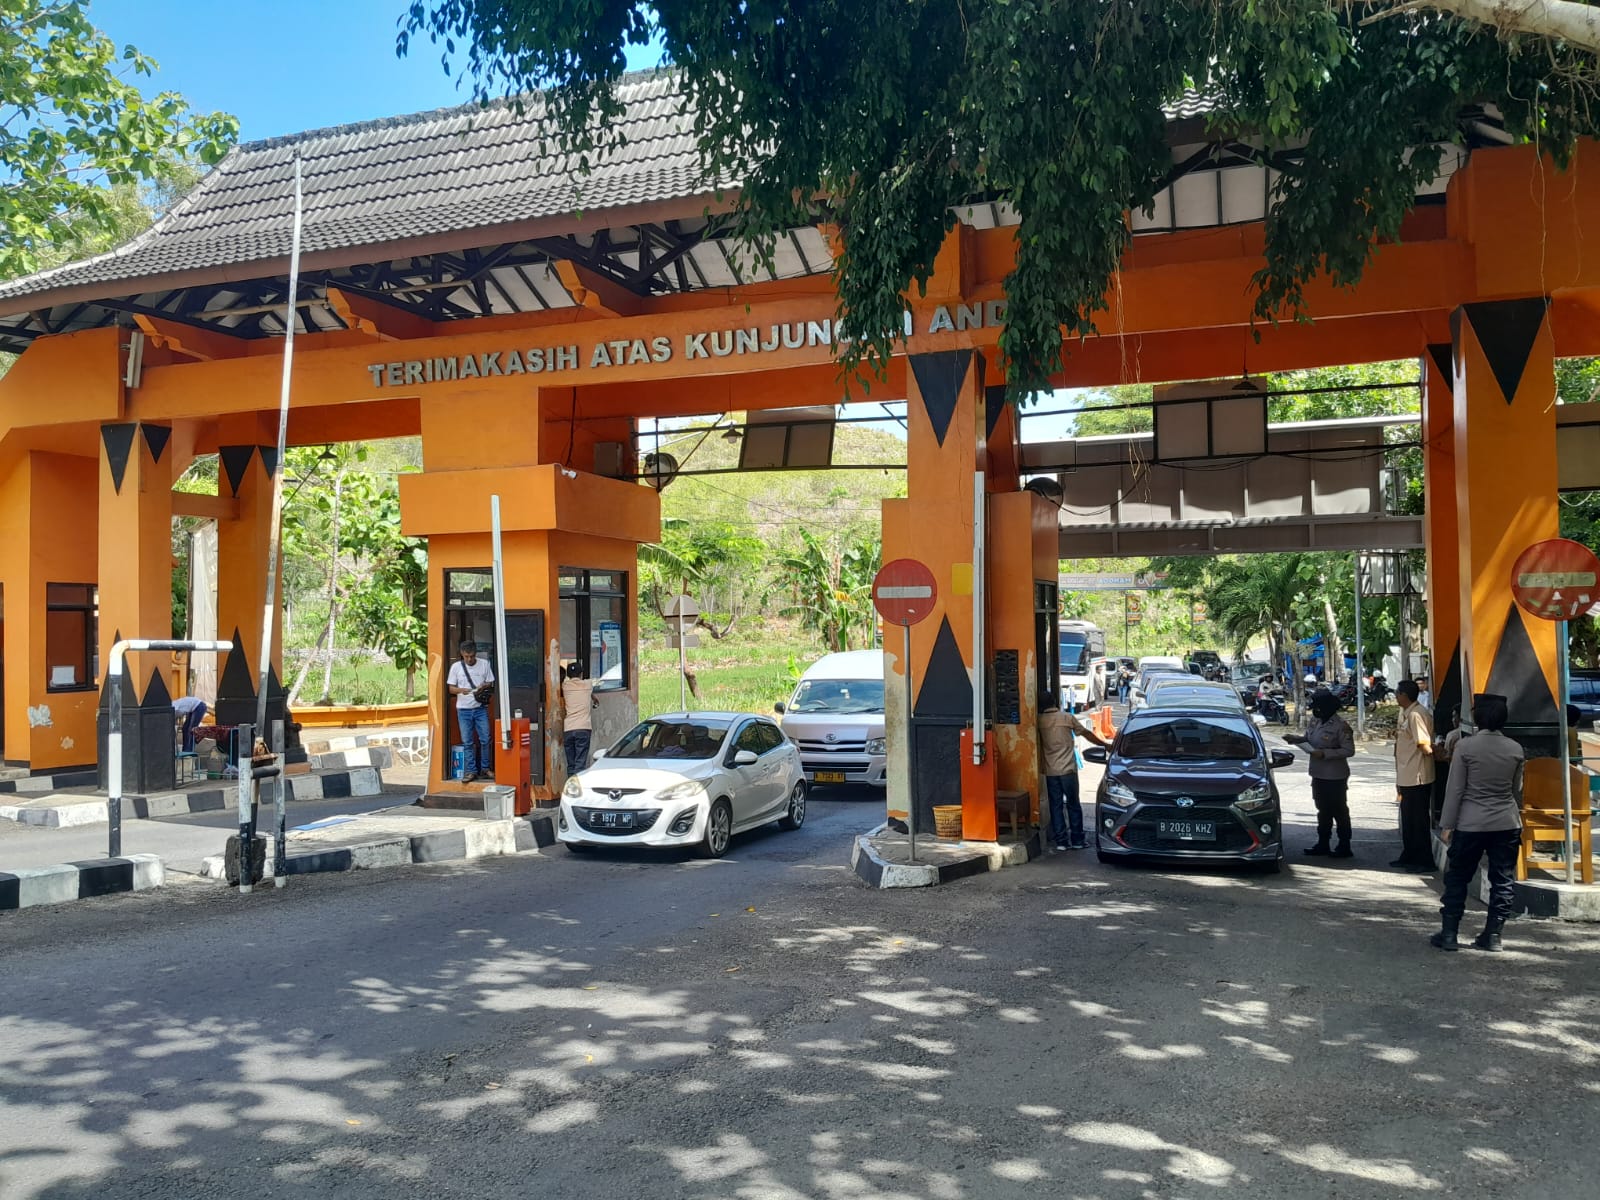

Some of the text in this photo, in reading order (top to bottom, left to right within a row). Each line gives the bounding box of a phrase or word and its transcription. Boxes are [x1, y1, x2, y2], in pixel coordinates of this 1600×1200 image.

[367, 344, 579, 388] TERIMAKASIH
[589, 336, 672, 369] ATAS
[684, 309, 913, 360] KUNJUNG
[591, 813, 596, 822] E
[1160, 822, 1212, 834] B 2026 KHZ
